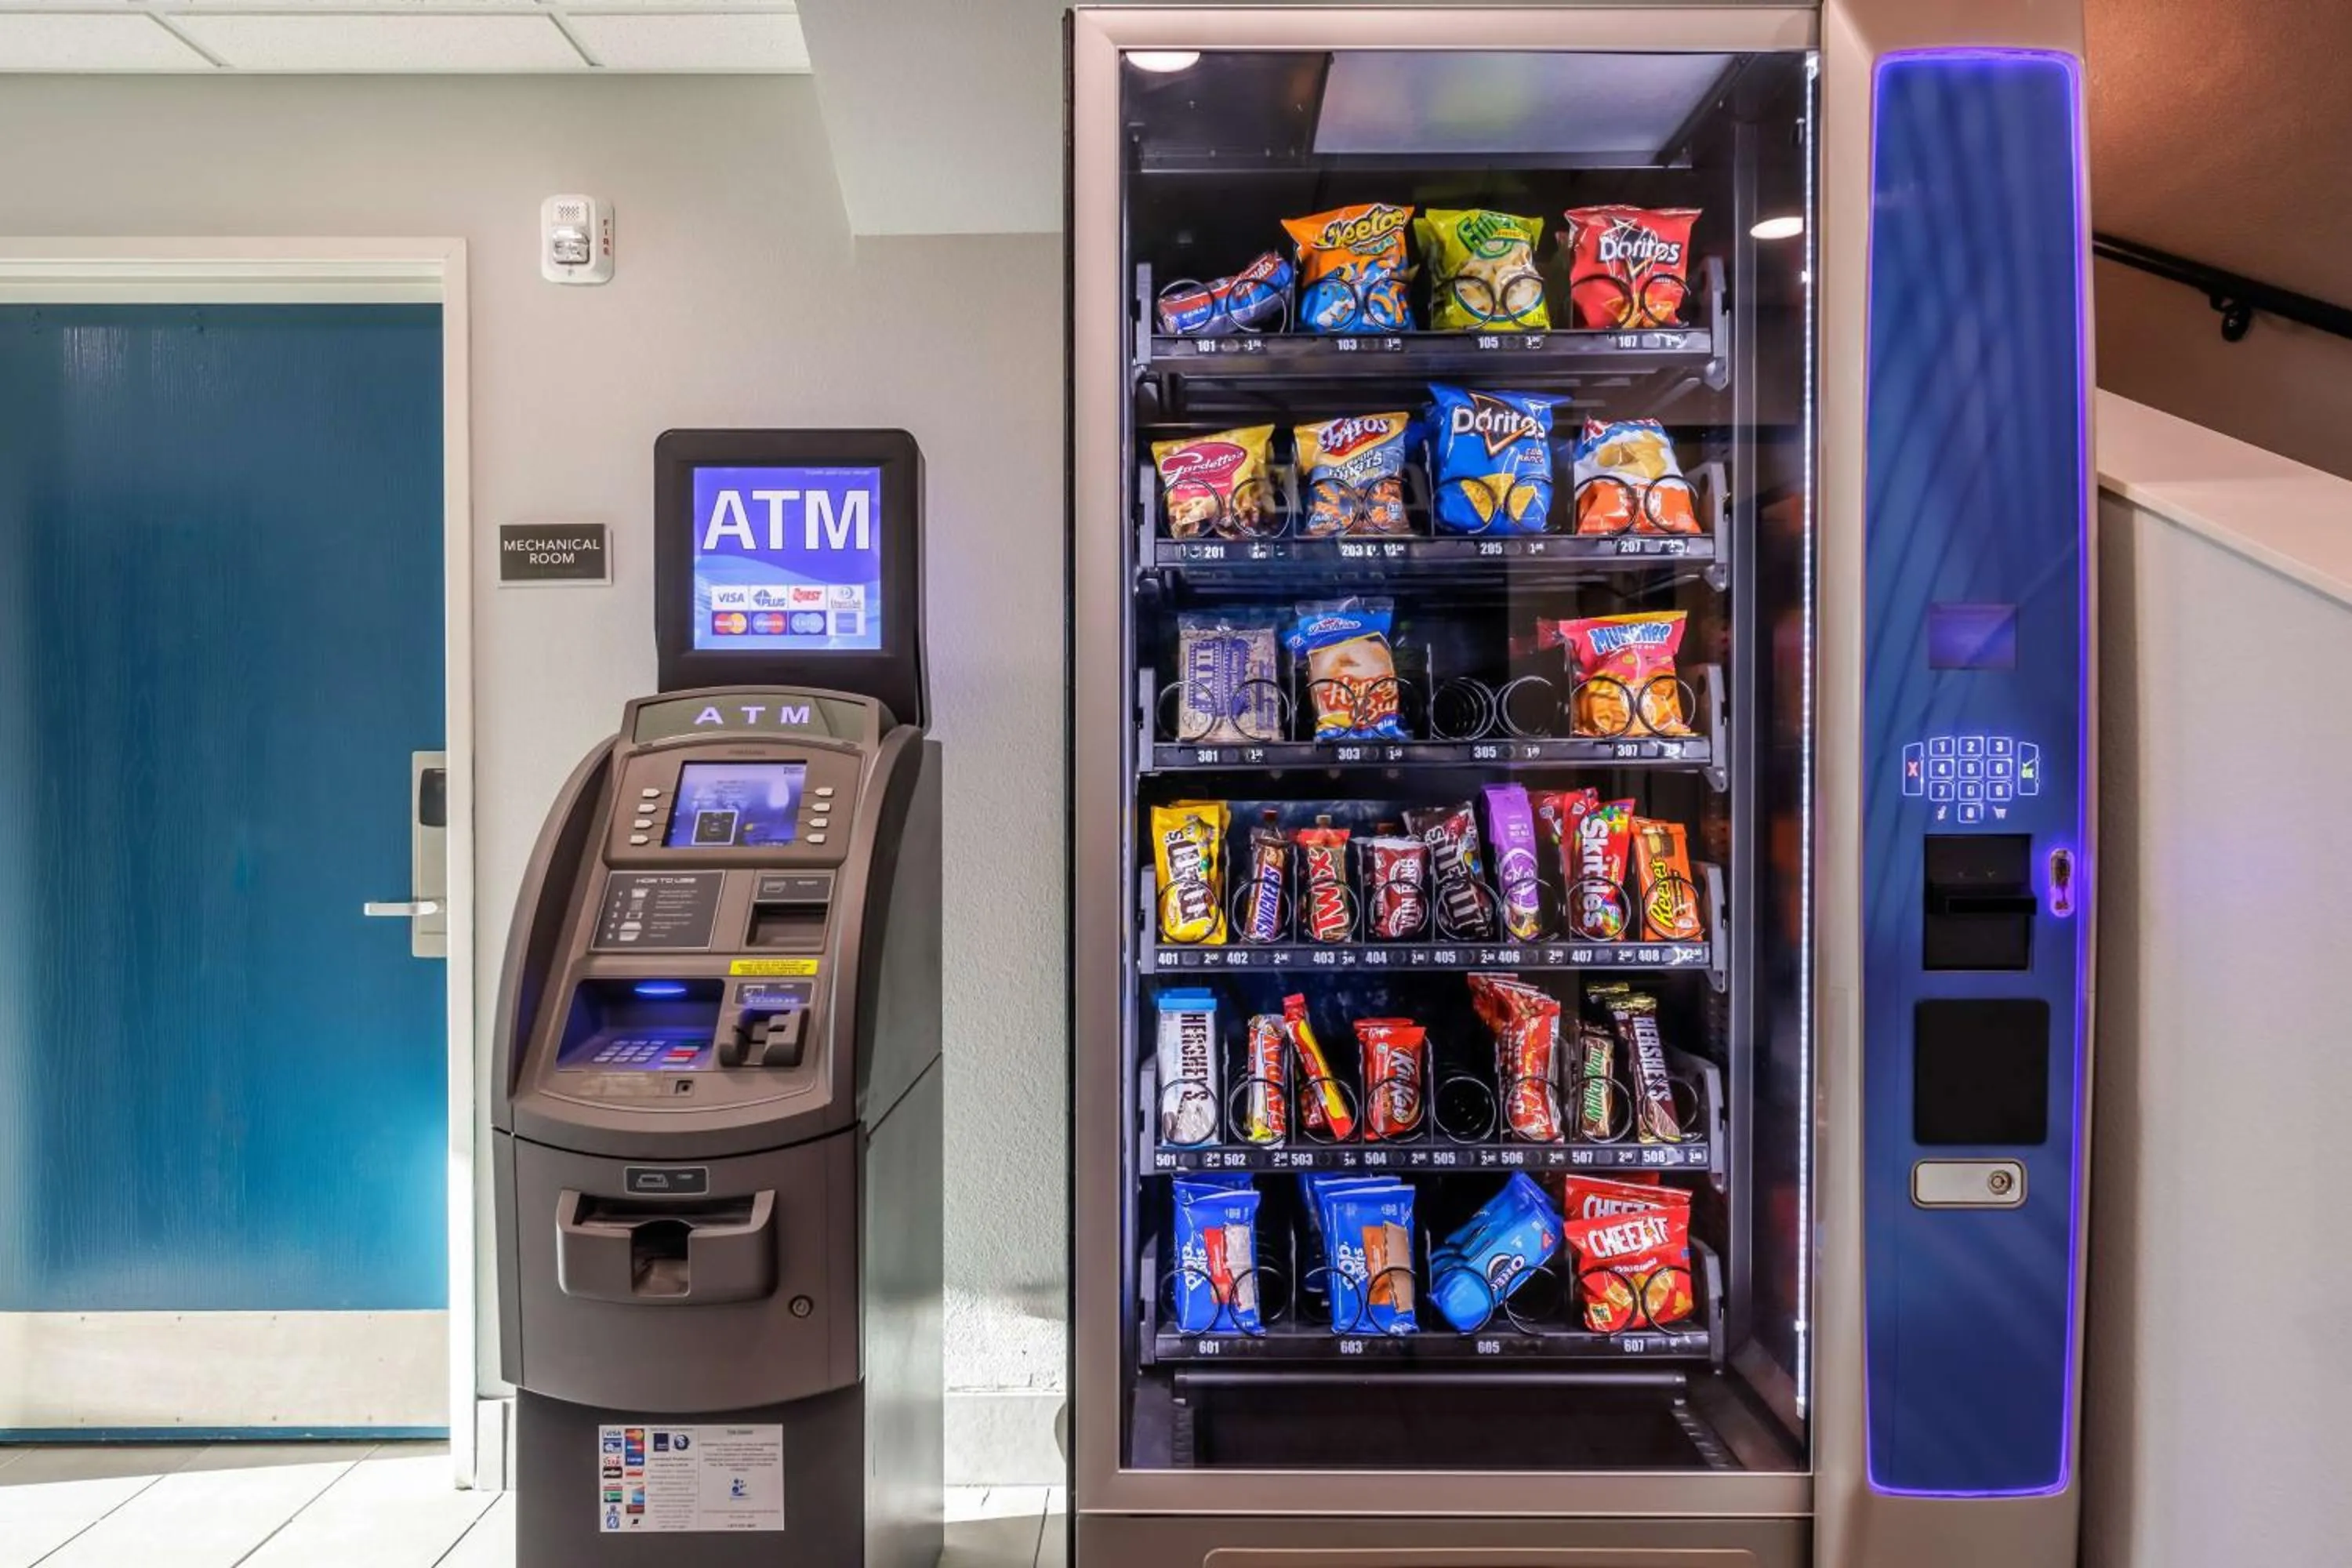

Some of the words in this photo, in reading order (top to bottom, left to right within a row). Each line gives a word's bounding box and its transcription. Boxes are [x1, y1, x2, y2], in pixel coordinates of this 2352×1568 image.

[1599, 235, 1682, 265] Doritos
[1196, 339, 1216, 352] 101
[1337, 339, 1357, 350] 103
[1478, 336, 1498, 349] 105
[1618, 334, 1638, 347] 107
[1454, 406, 1545, 438] Doritos
[702, 489, 869, 550] ATM
[504, 539, 601, 551] MECHANICAL
[1341, 545, 1363, 557] 203
[1480, 542, 1503, 555] 205
[1621, 540, 1641, 554] 207
[529, 553, 575, 564] ROOM
[1204, 546, 1225, 559] 201
[718, 592, 745, 604] VISA
[1338, 747, 1360, 760] 303
[1474, 746, 1497, 758] 305
[1617, 743, 1638, 757] 307
[1967, 741, 1975, 753] 2
[1198, 749, 1218, 762] 301
[1938, 763, 1945, 775] 4
[1581, 817, 1611, 928] Skittles
[1647, 857, 1675, 929] Reese's
[1255, 866, 1282, 940] SNICKERS
[1158, 953, 1178, 964] 401
[1227, 952, 1248, 964] 402
[1313, 952, 1334, 964] 403
[1365, 951, 1387, 964] 404
[1434, 950, 1456, 963] 405
[1498, 950, 1520, 963] 406
[1572, 949, 1592, 963] 407
[1639, 948, 1660, 962] 408
[1635, 1018, 1671, 1102] HERSHEY'S
[1156, 1153, 1175, 1166] 501
[1225, 1153, 1245, 1165] 502
[1292, 1152, 1312, 1165] 503
[1365, 1152, 1386, 1164] 504
[1434, 1152, 1455, 1164] 505
[1501, 1152, 1523, 1164] 506
[1572, 1151, 1593, 1164] 507
[1643, 1150, 1665, 1163] 508
[1199, 1340, 1219, 1353] 601
[1340, 1340, 1363, 1352] 603
[1478, 1341, 1500, 1354] 605
[1624, 1339, 1644, 1352] 607
